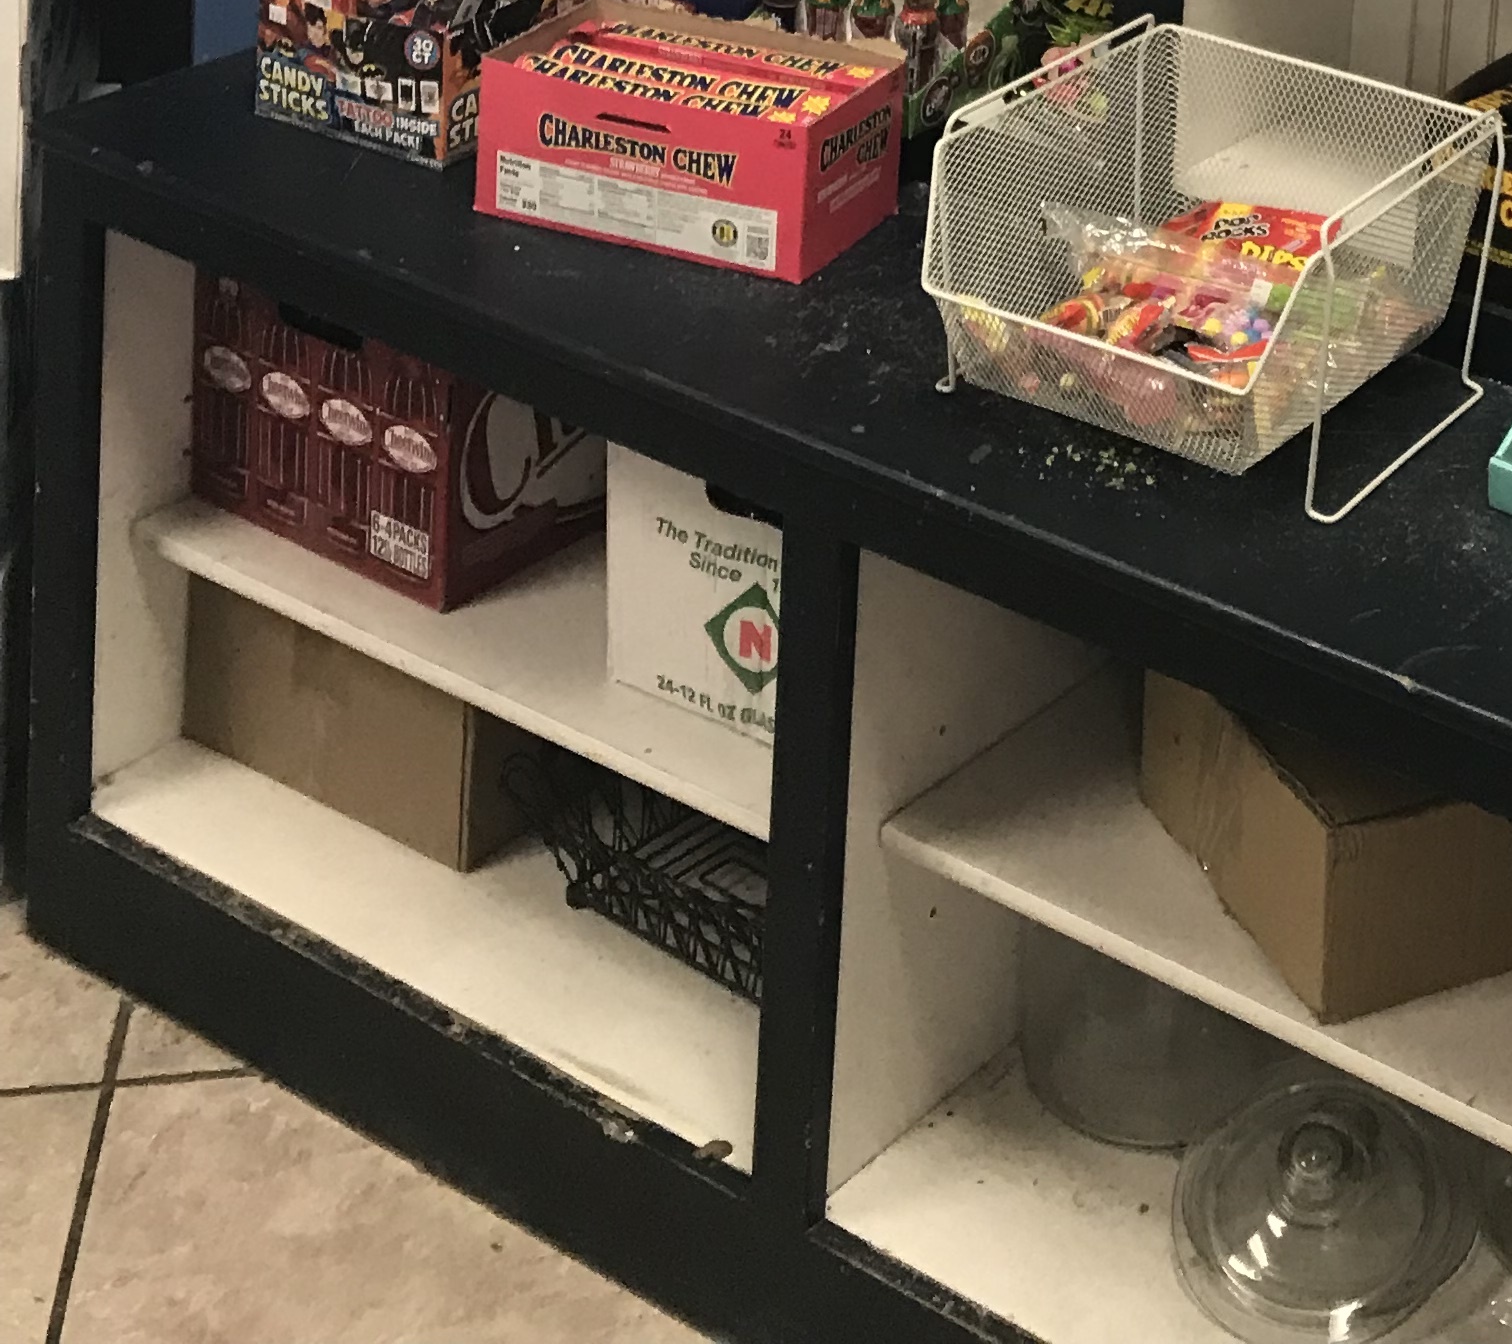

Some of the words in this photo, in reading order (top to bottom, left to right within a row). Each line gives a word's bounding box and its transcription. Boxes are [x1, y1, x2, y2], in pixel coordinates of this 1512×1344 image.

[412, 37, 434, 54] 30
[412, 50, 432, 67] CT
[260, 56, 326, 98] CANDY
[554, 43, 715, 94] CHARLESTON
[717, 77, 810, 110] CHEW
[259, 79, 330, 121] STICKS
[384, 130, 422, 151] PACK!
[396, 115, 439, 138] INSIDE
[820, 103, 893, 173] CHARLESTON
[856, 124, 891, 166] CHEW
[538, 112, 668, 167] CHARLESTON
[671, 147, 738, 188] CHEW
[1240, 238, 1310, 274] DIPS
[656, 515, 689, 545] The
[694, 528, 778, 573] Tradition
[688, 551, 743, 582] Since
[738, 618, 773, 663] N
[656, 673, 697, 705] 24-12
[717, 701, 738, 721] OZ
[740, 702, 776, 735] GLAS
